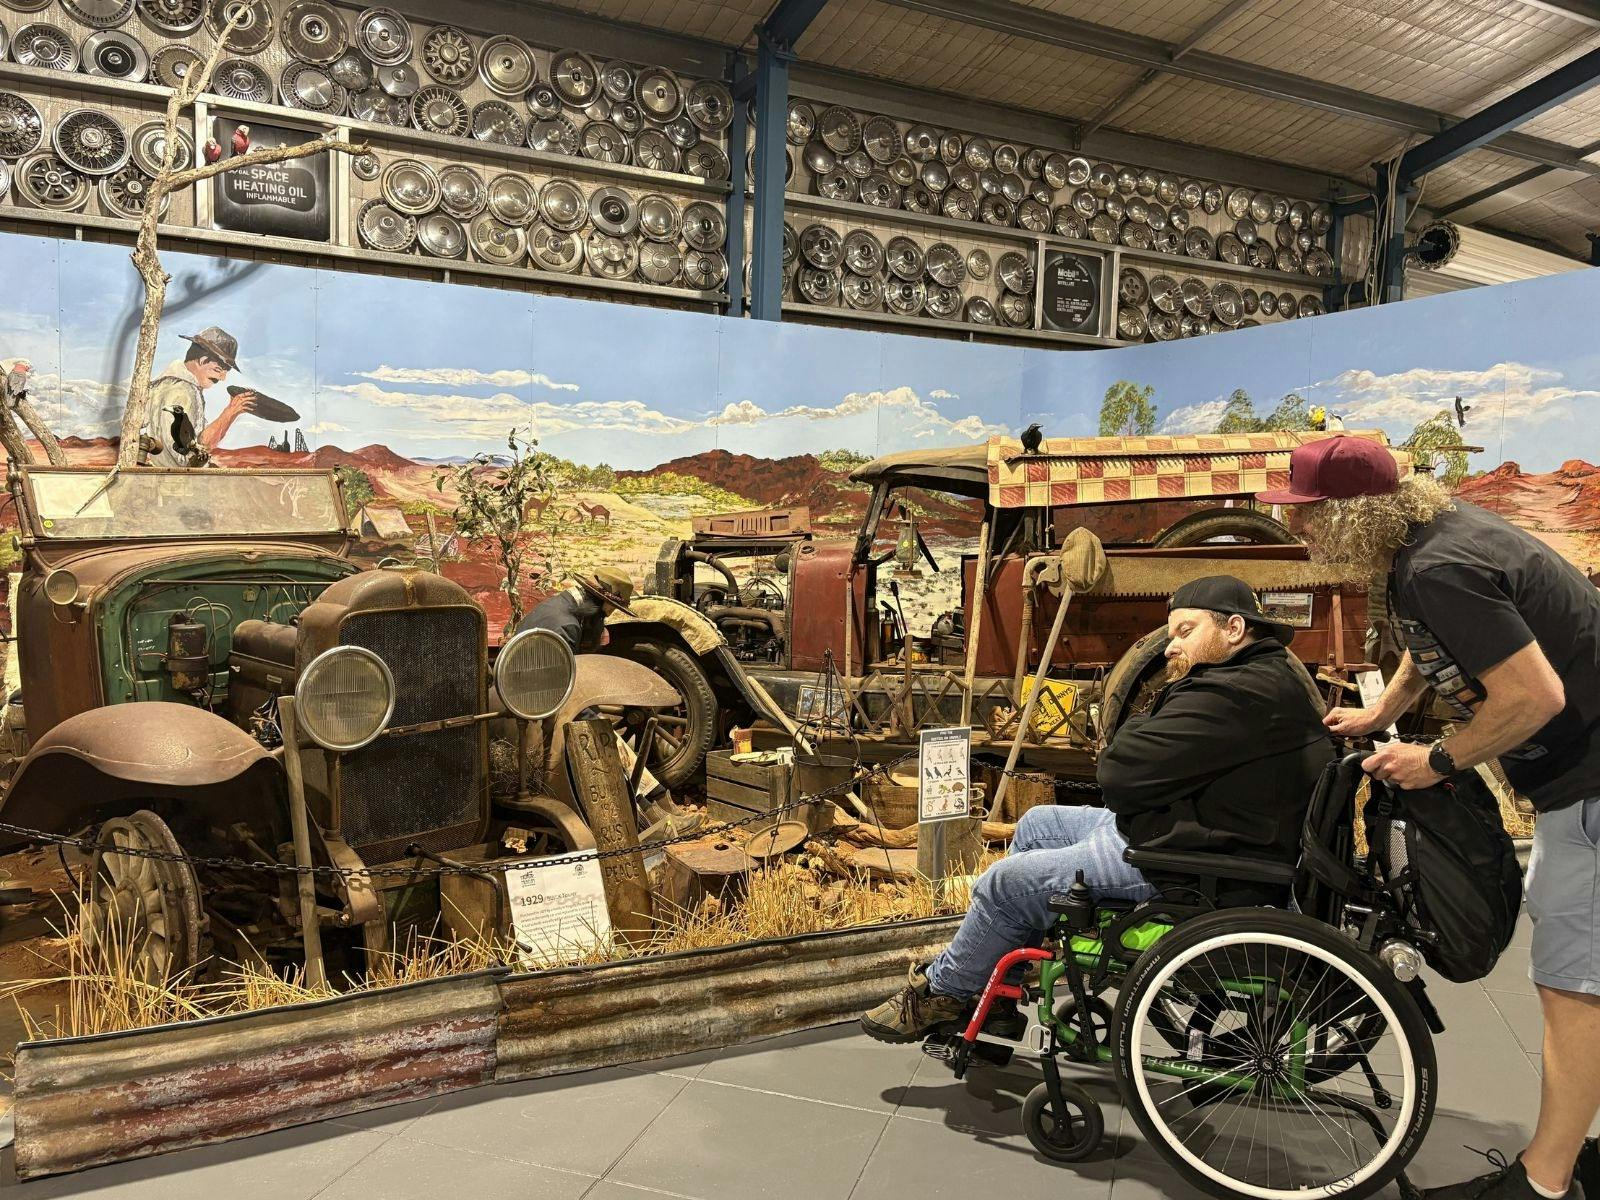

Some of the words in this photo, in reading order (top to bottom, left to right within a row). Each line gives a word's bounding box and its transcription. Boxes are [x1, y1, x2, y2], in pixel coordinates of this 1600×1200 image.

[251, 168, 290, 183] SPACE
[233, 180, 286, 195] HEATING
[288, 187, 308, 198] OIL
[246, 192, 297, 205] INFLAMMABLE
[1057, 268, 1076, 278] Mobil
[604, 860, 640, 884] PEACE
[520, 893, 544, 907] 1929
[1123, 954, 1161, 1018] MARATHON
[1119, 1021, 1127, 1057] PLUS
[1398, 1067, 1429, 1158] SCHWALBE
